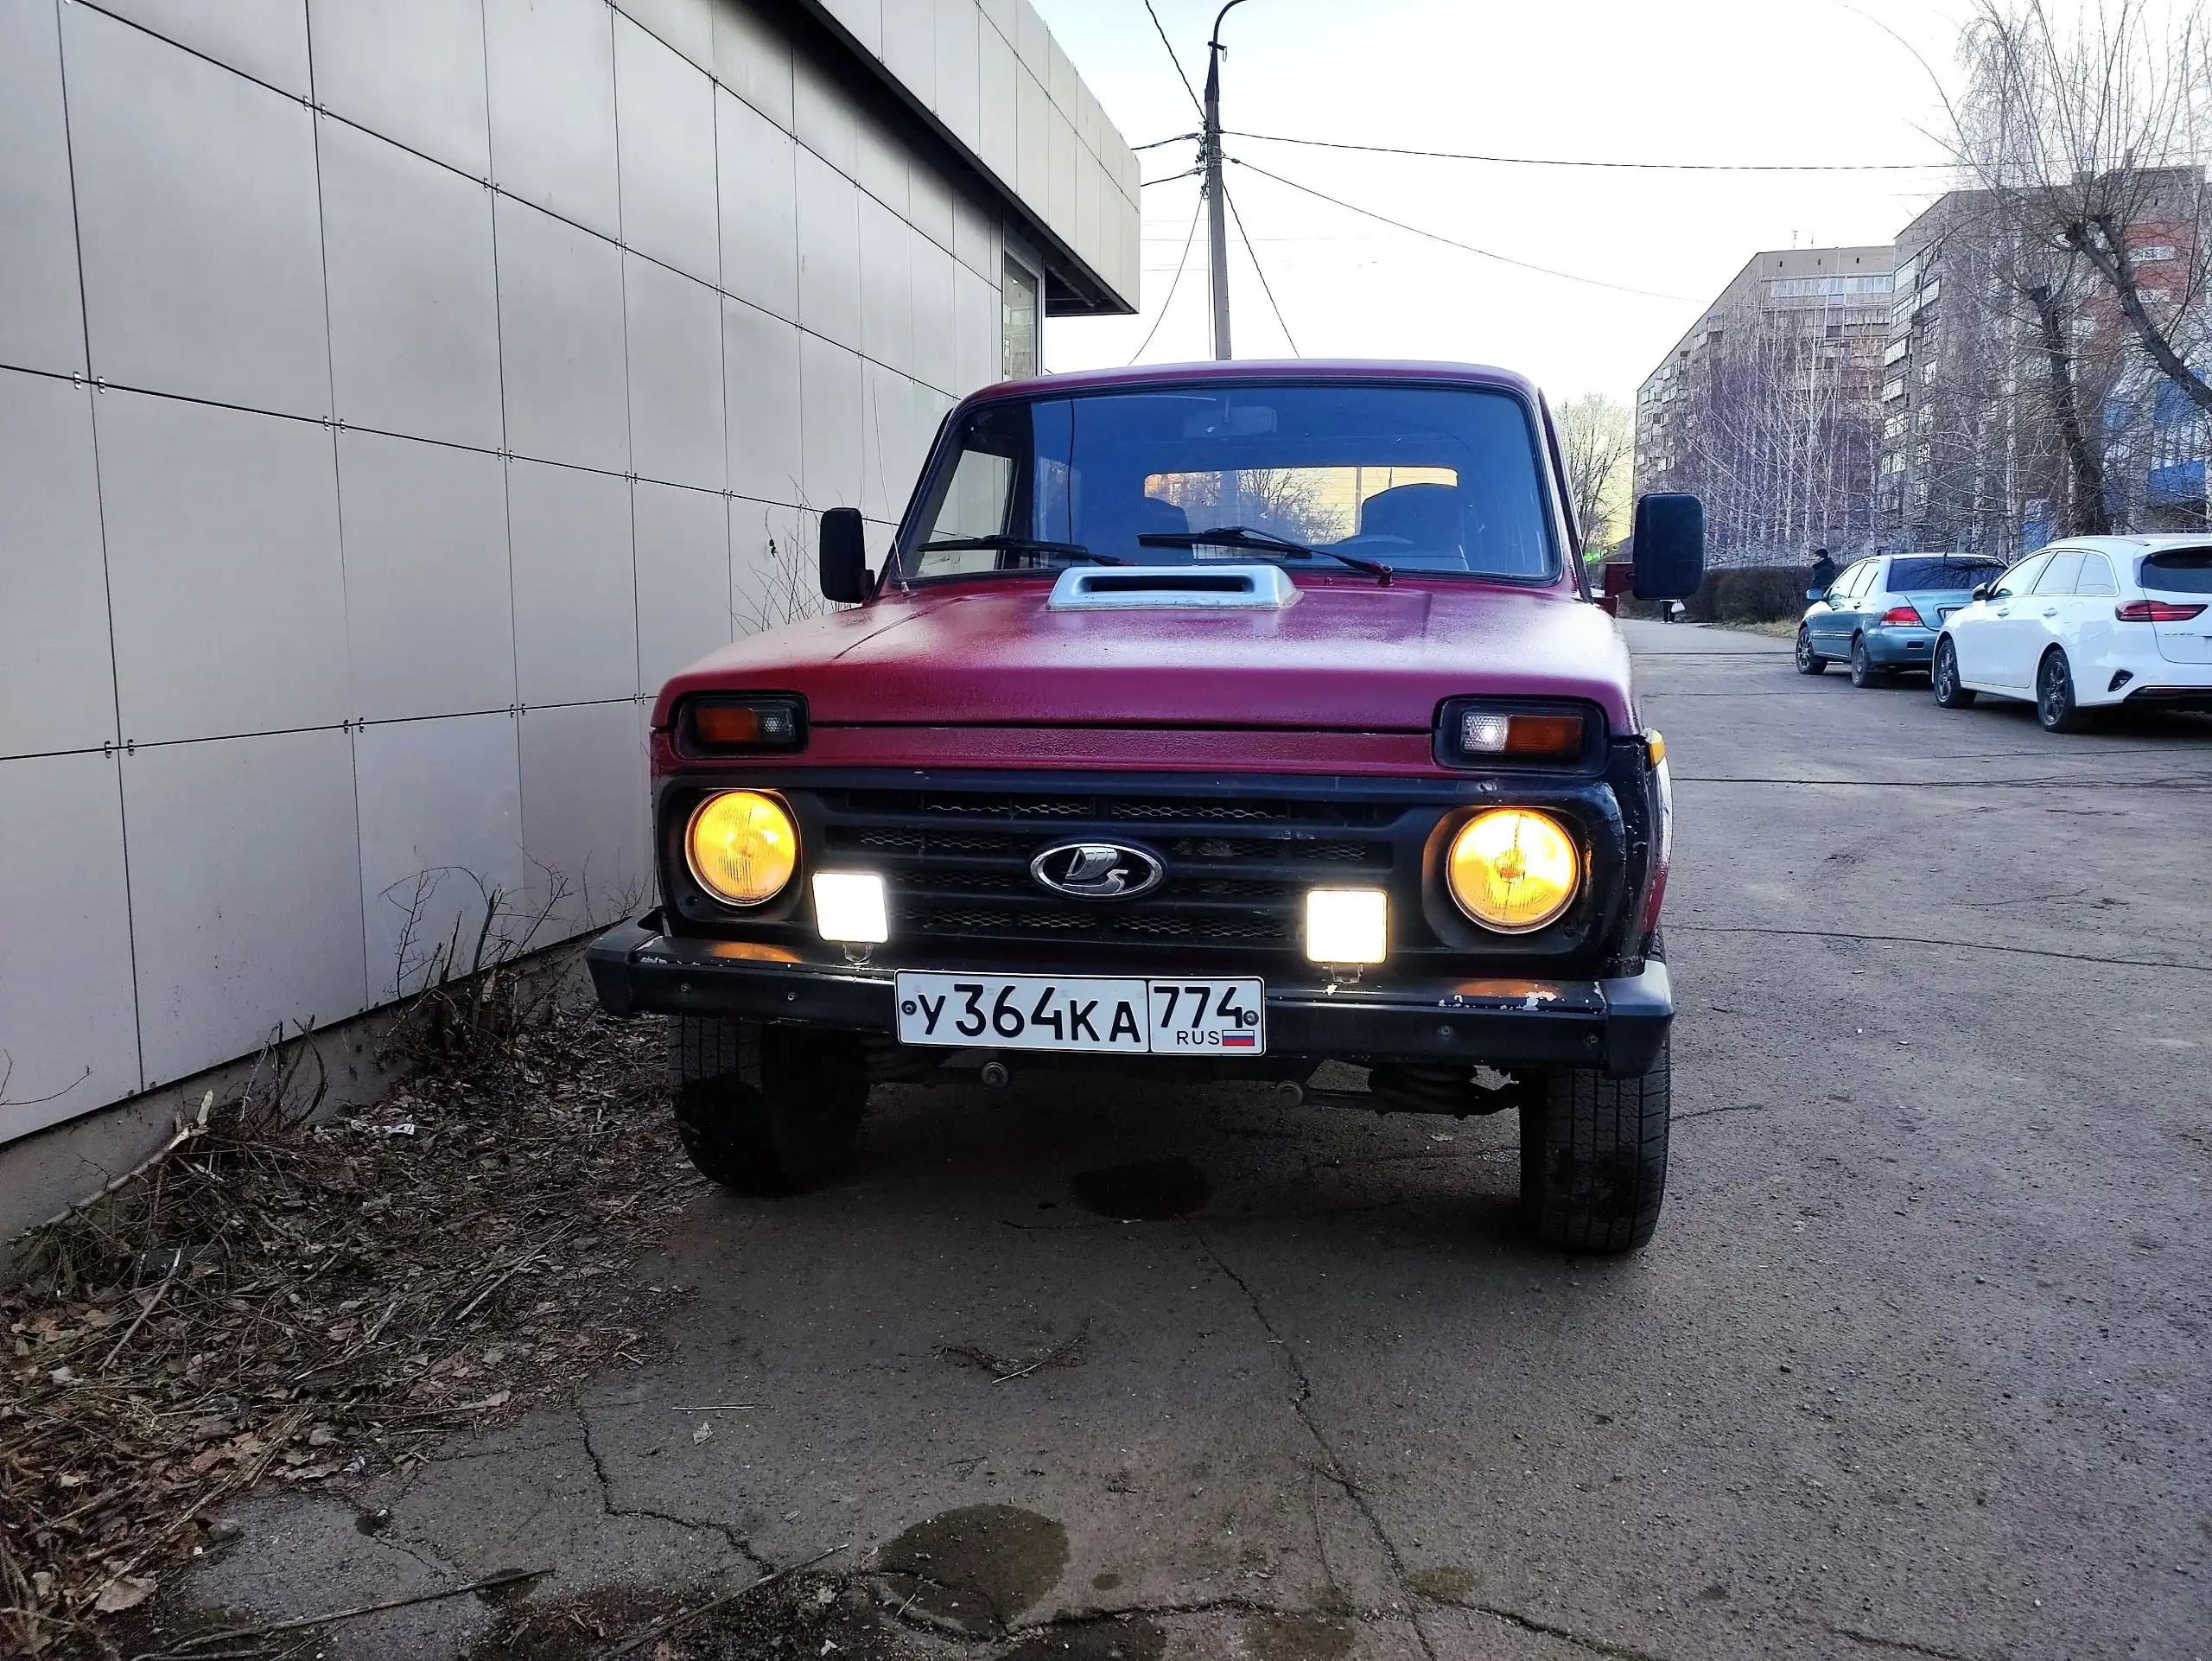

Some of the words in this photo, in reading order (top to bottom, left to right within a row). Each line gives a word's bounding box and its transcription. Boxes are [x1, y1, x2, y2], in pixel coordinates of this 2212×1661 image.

[918, 983, 1141, 1043] У364КА
[1154, 985, 1244, 1029] 774
[1176, 1030, 1220, 1046] RUS
